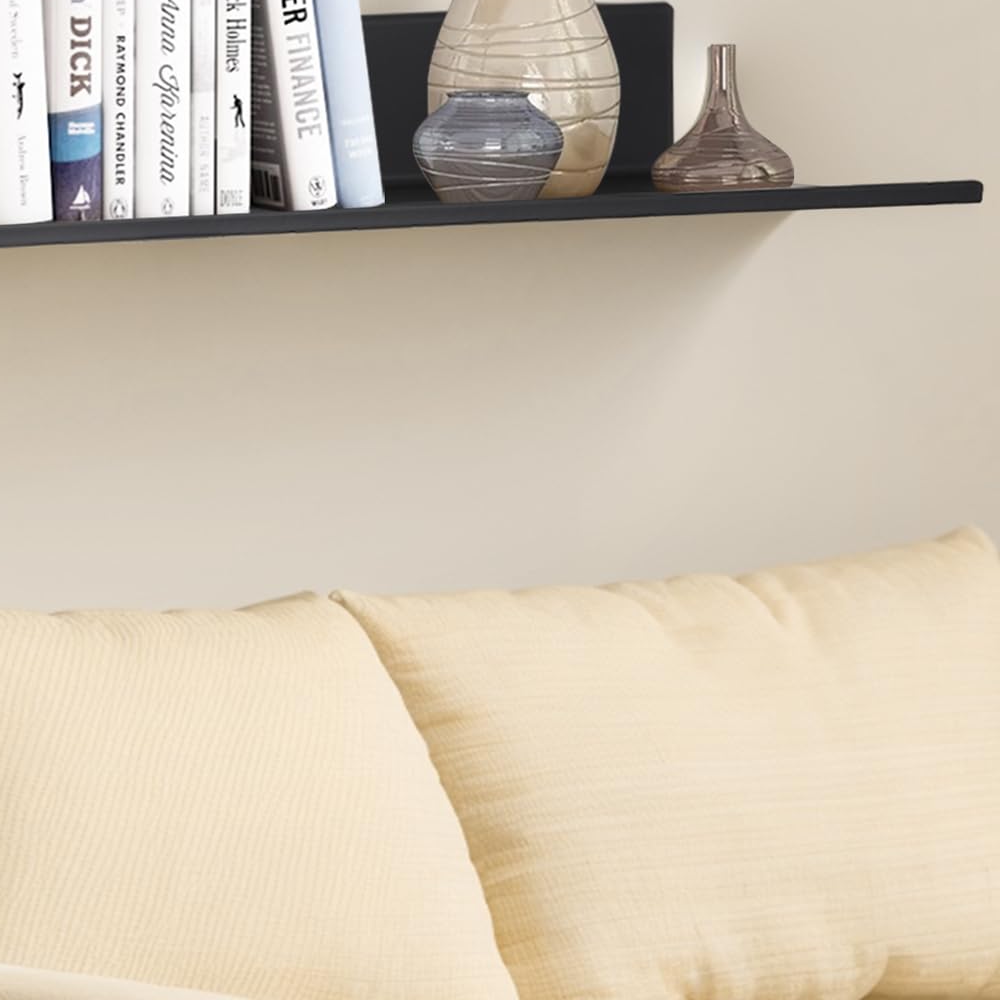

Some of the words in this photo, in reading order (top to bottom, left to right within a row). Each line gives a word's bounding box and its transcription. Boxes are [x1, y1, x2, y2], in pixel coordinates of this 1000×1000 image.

[69, 15, 92, 98] DICK
[115, 34, 127, 108] RAYMOND
[224, 17, 247, 74] Holmes
[151, 63, 181, 187] Karenina
[285, 32, 323, 140] FINANCE
[115, 111, 127, 186] CHANDLER
